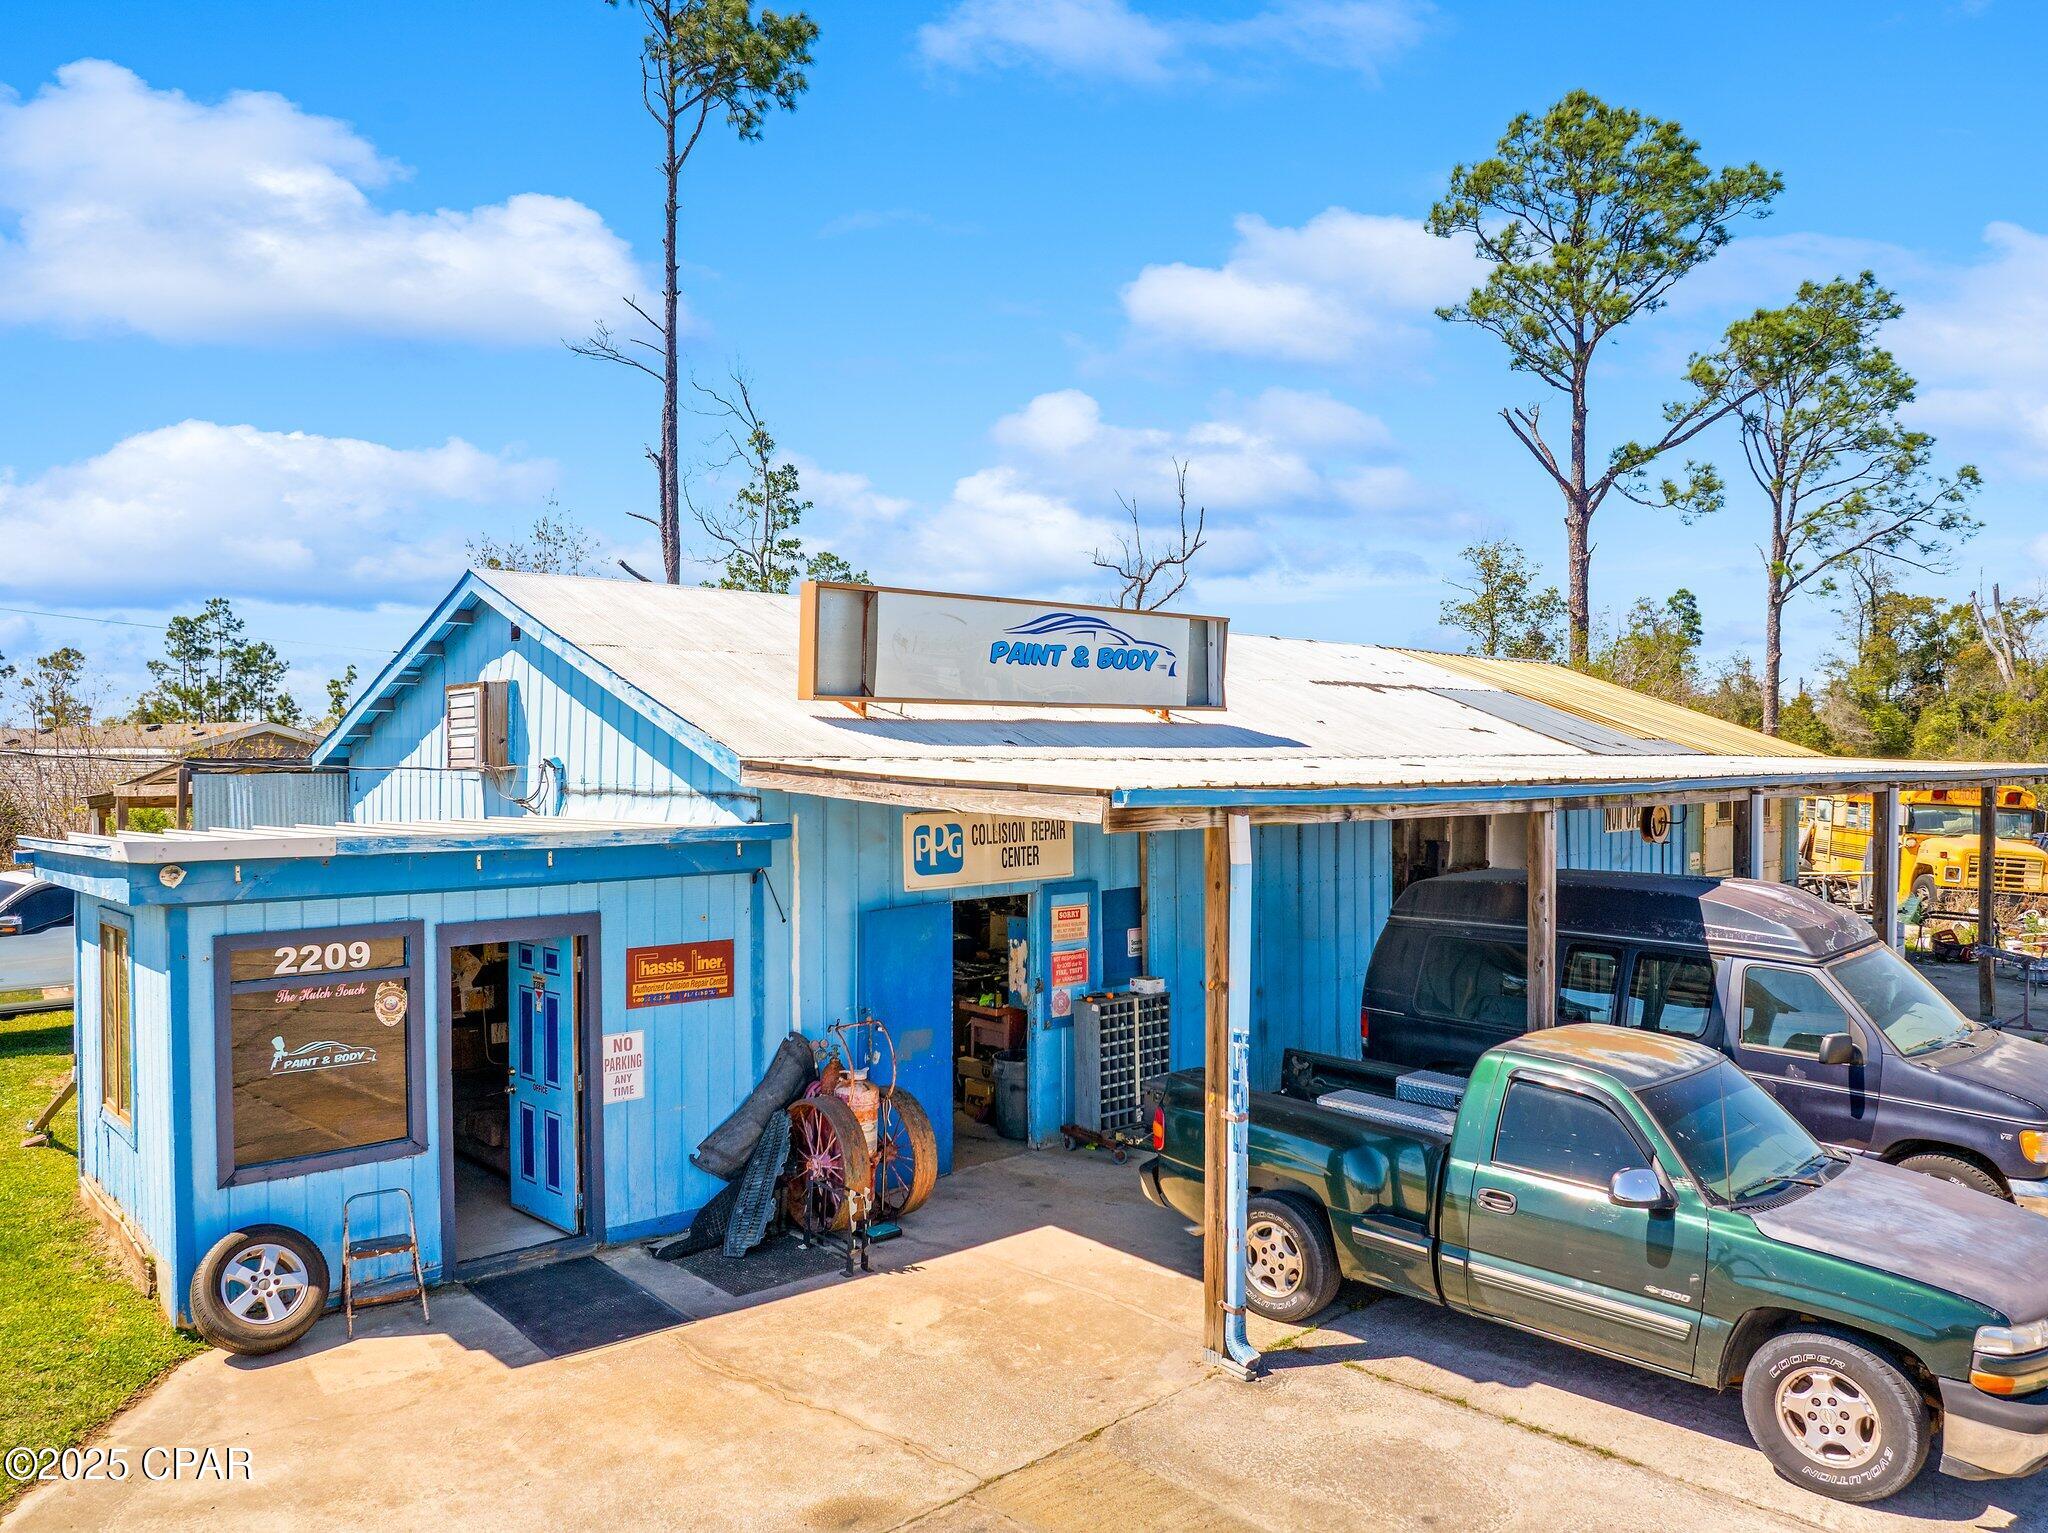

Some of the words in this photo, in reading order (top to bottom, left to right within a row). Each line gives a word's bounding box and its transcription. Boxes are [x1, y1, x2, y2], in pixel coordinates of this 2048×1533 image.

[989, 640, 1068, 667] PAINT
[1071, 645, 1090, 669] &
[1096, 647, 1159, 671] BODY
[971, 821, 1026, 845] COLLISION
[1031, 819, 1066, 841] REPAIR
[915, 823, 962, 866] PPG
[1001, 845, 1040, 868] CENTER
[1058, 909, 1080, 919] SORRY
[273, 941, 371, 975] 2209
[634, 952, 686, 982] Chassis
[691, 949, 726, 977] Liner
[275, 989, 297, 1004] The
[298, 986, 333, 1002] Hutch
[335, 982, 367, 997] Touch
[634, 982, 665, 993] Authorized
[666, 980, 690, 991] Collision
[690, 979, 708, 988] Repair
[709, 976, 728, 986] Center
[613, 1036, 633, 1053] NO
[283, 1056, 319, 1069] PAINT
[321, 1055, 331, 1065] &
[334, 1050, 365, 1063] BODY
[604, 1053, 642, 1072] PARKING
[612, 1085, 635, 1097] TIME
[614, 1073, 633, 1085] ANY
[1249, 1211, 1299, 1238] COOPER
[1245, 1285, 1298, 1310] EVOLUTIO
[1768, 1353, 1846, 1378] COOPER
[1802, 1446, 1893, 1485] EVOLUTION
